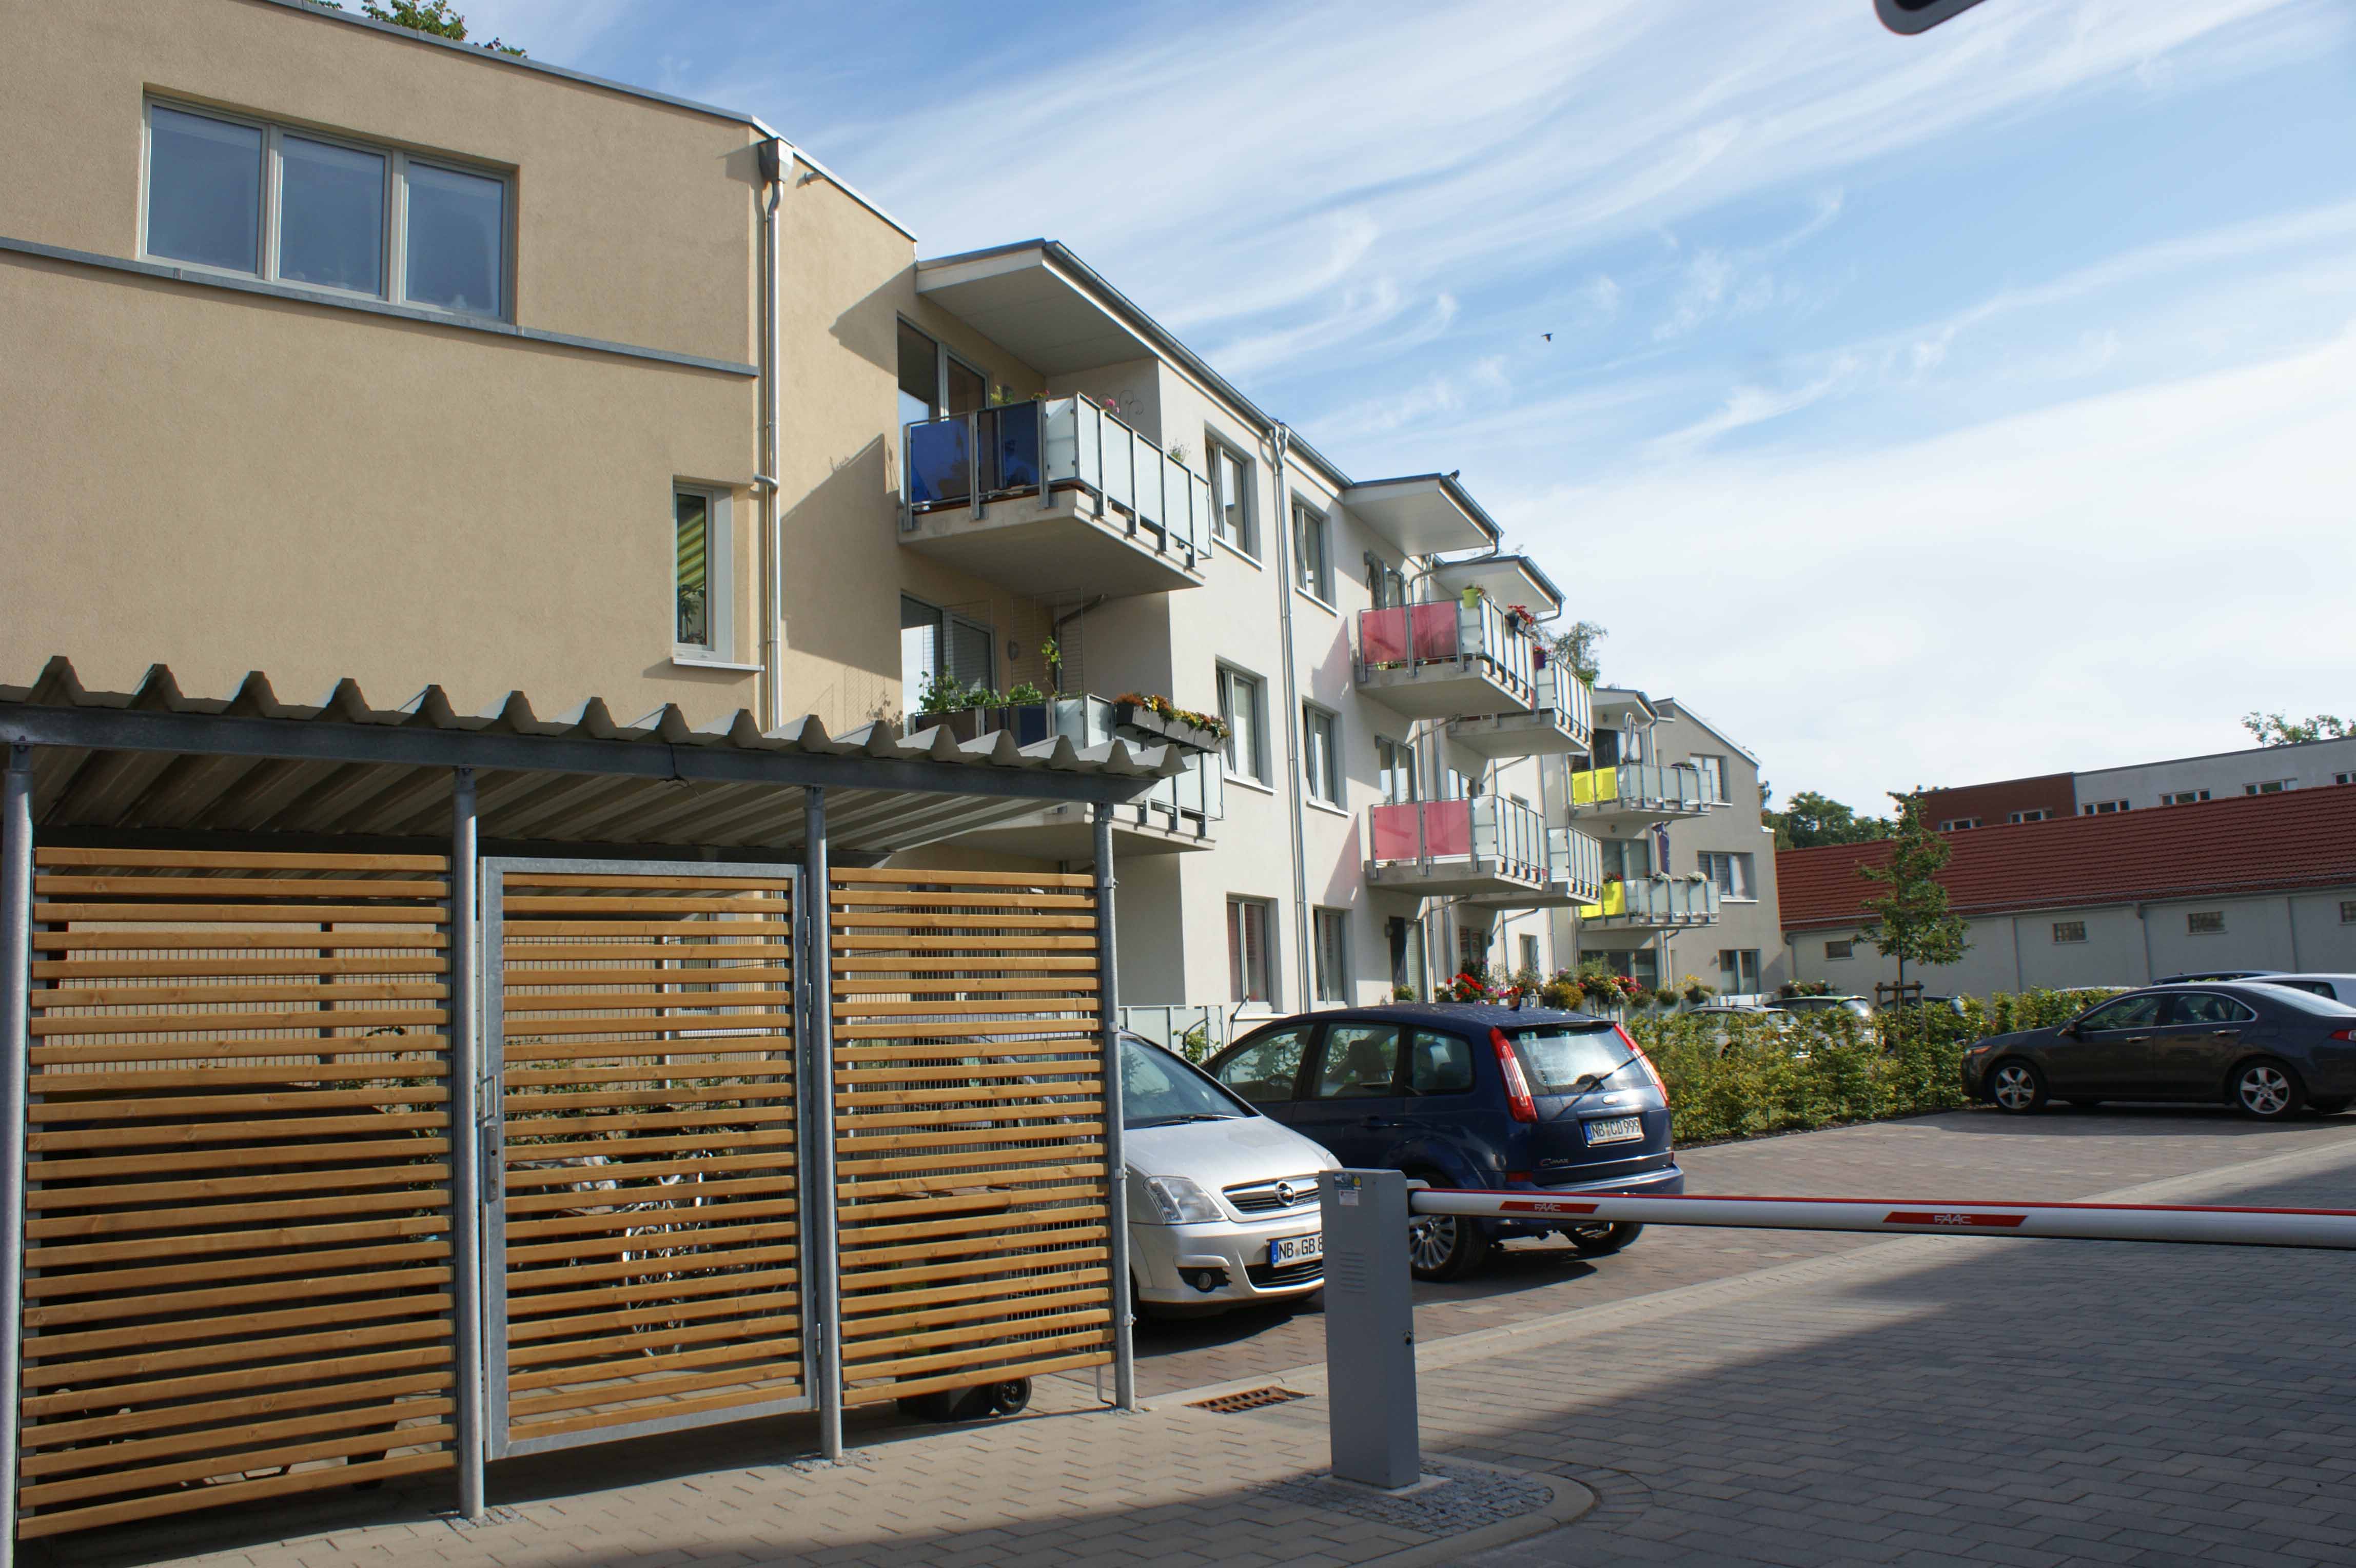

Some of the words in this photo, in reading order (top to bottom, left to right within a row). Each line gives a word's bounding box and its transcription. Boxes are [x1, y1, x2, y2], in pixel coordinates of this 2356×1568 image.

[1591, 1123, 1605, 1138] NB
[1623, 1119, 1639, 1133] 999
[1535, 1202, 1561, 1211] FAAC
[1934, 1213, 1972, 1224] FAAC
[1279, 1242, 1293, 1259] NB
[1302, 1238, 1315, 1255] GB
